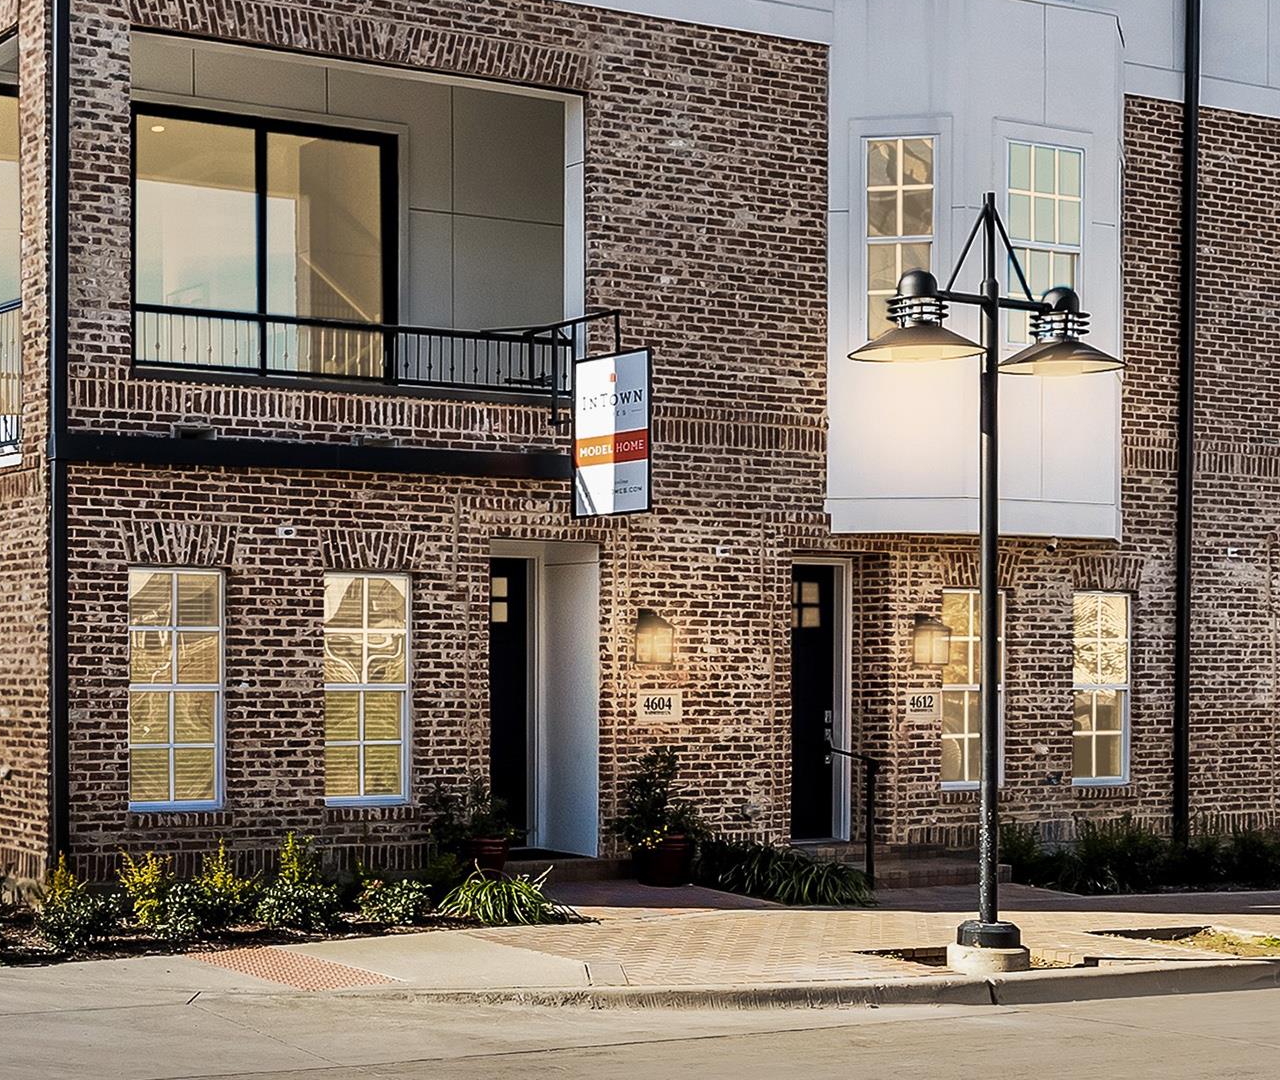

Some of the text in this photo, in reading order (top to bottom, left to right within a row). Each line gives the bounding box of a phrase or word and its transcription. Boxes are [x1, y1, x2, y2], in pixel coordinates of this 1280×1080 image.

[580, 439, 644, 458] MODEL HOME
[643, 696, 672, 711] 4604
[909, 695, 934, 708] 4612
